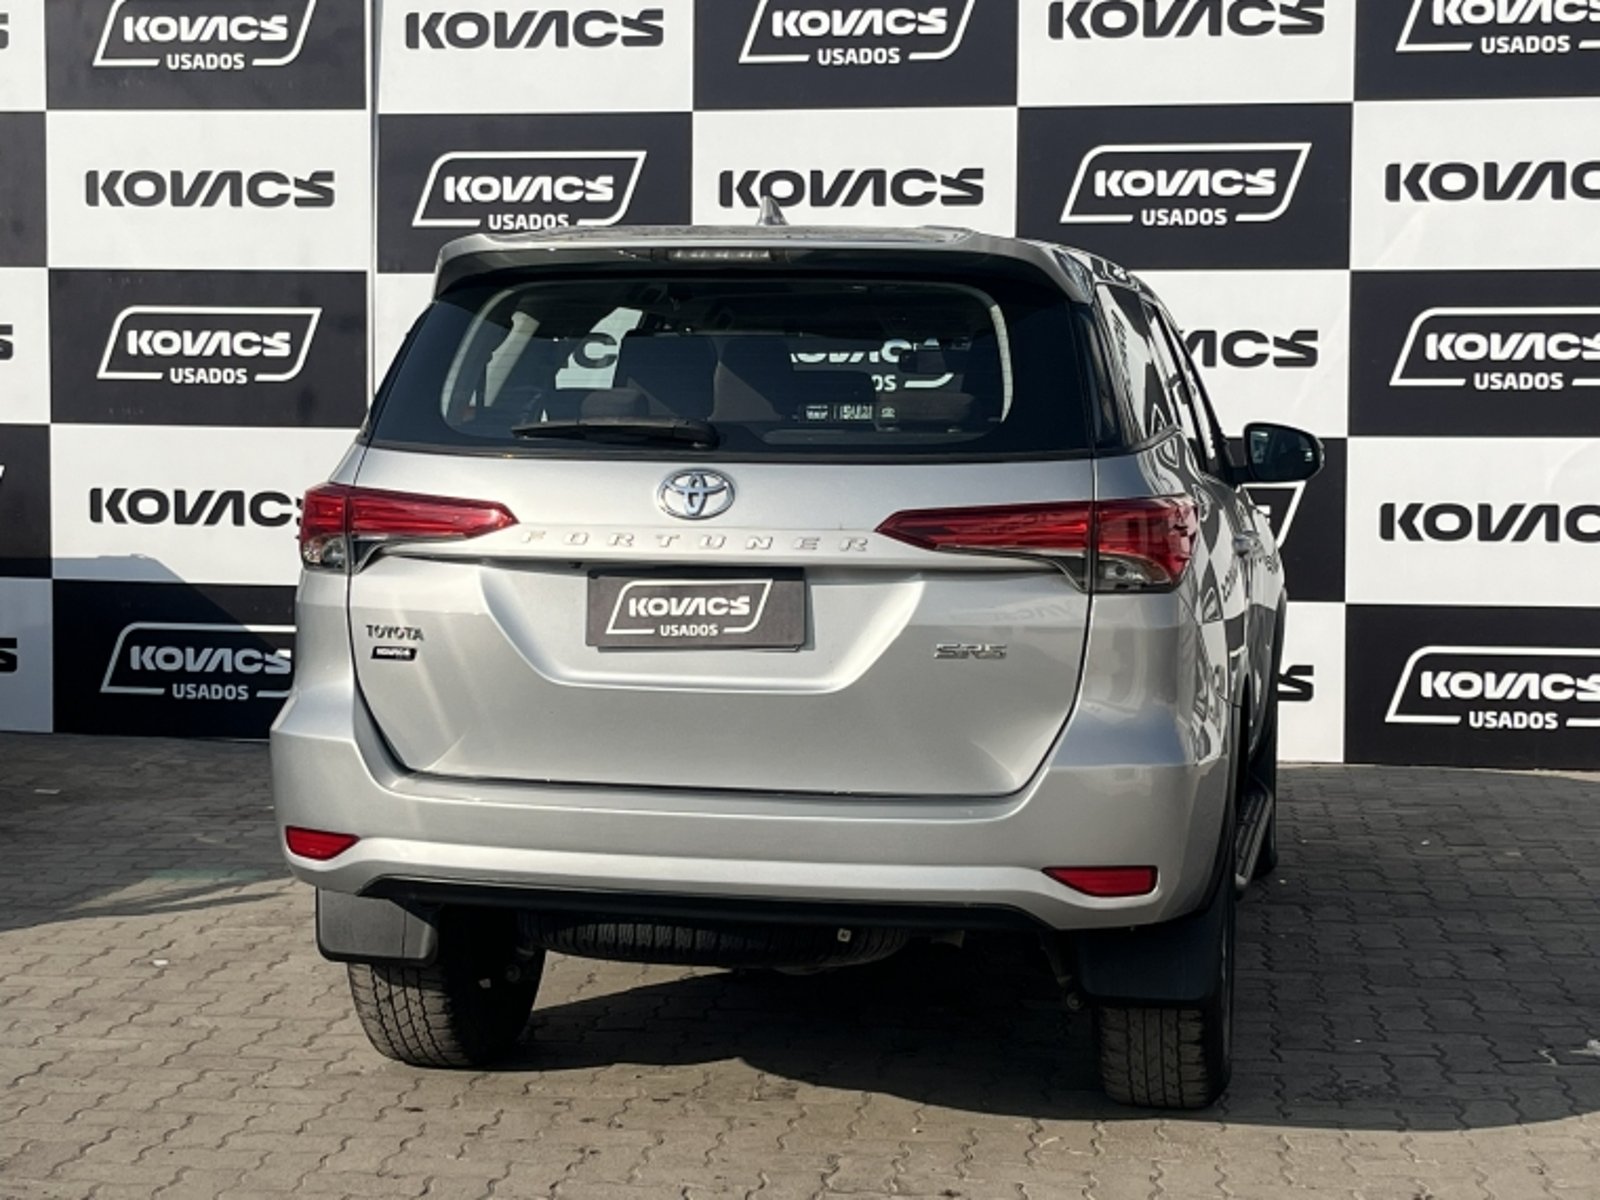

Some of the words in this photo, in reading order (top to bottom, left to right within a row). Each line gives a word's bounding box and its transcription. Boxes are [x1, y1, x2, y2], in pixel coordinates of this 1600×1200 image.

[124, 15, 288, 42] KOVACS
[406, 9, 664, 49] KOVACS
[773, 7, 947, 37] KOVACS
[1049, 0, 1324, 39] KOVACS
[818, 48, 900, 65] USADOS
[1482, 36, 1571, 53] USADOS
[167, 53, 244, 69] USADOS
[86, 170, 334, 207] KOVACS
[445, 175, 613, 201] KOVACS
[719, 168, 984, 207] KOVACS
[1095, 168, 1275, 197] KOVACS
[1385, 161, 1600, 201] KOVAC
[489, 214, 570, 230] USADOS
[1142, 209, 1227, 226] USADOS
[128, 330, 290, 356] KOVACS
[1179, 330, 1318, 367] ACS
[170, 368, 247, 384] USADOS
[1475, 373, 1563, 389] USADOS
[90, 488, 303, 526] KOVAC
[1380, 503, 1600, 543] KOVAC
[520, 530, 867, 552] FORTUNER
[629, 595, 750, 617] KOVACS
[366, 624, 424, 641] TOYOTA
[660, 623, 718, 637] USADOS
[131, 646, 291, 674] KOVACS
[173, 684, 248, 700] USADOS
[1421, 672, 1600, 701] KOVACS
[1469, 711, 1558, 729] USADOS
